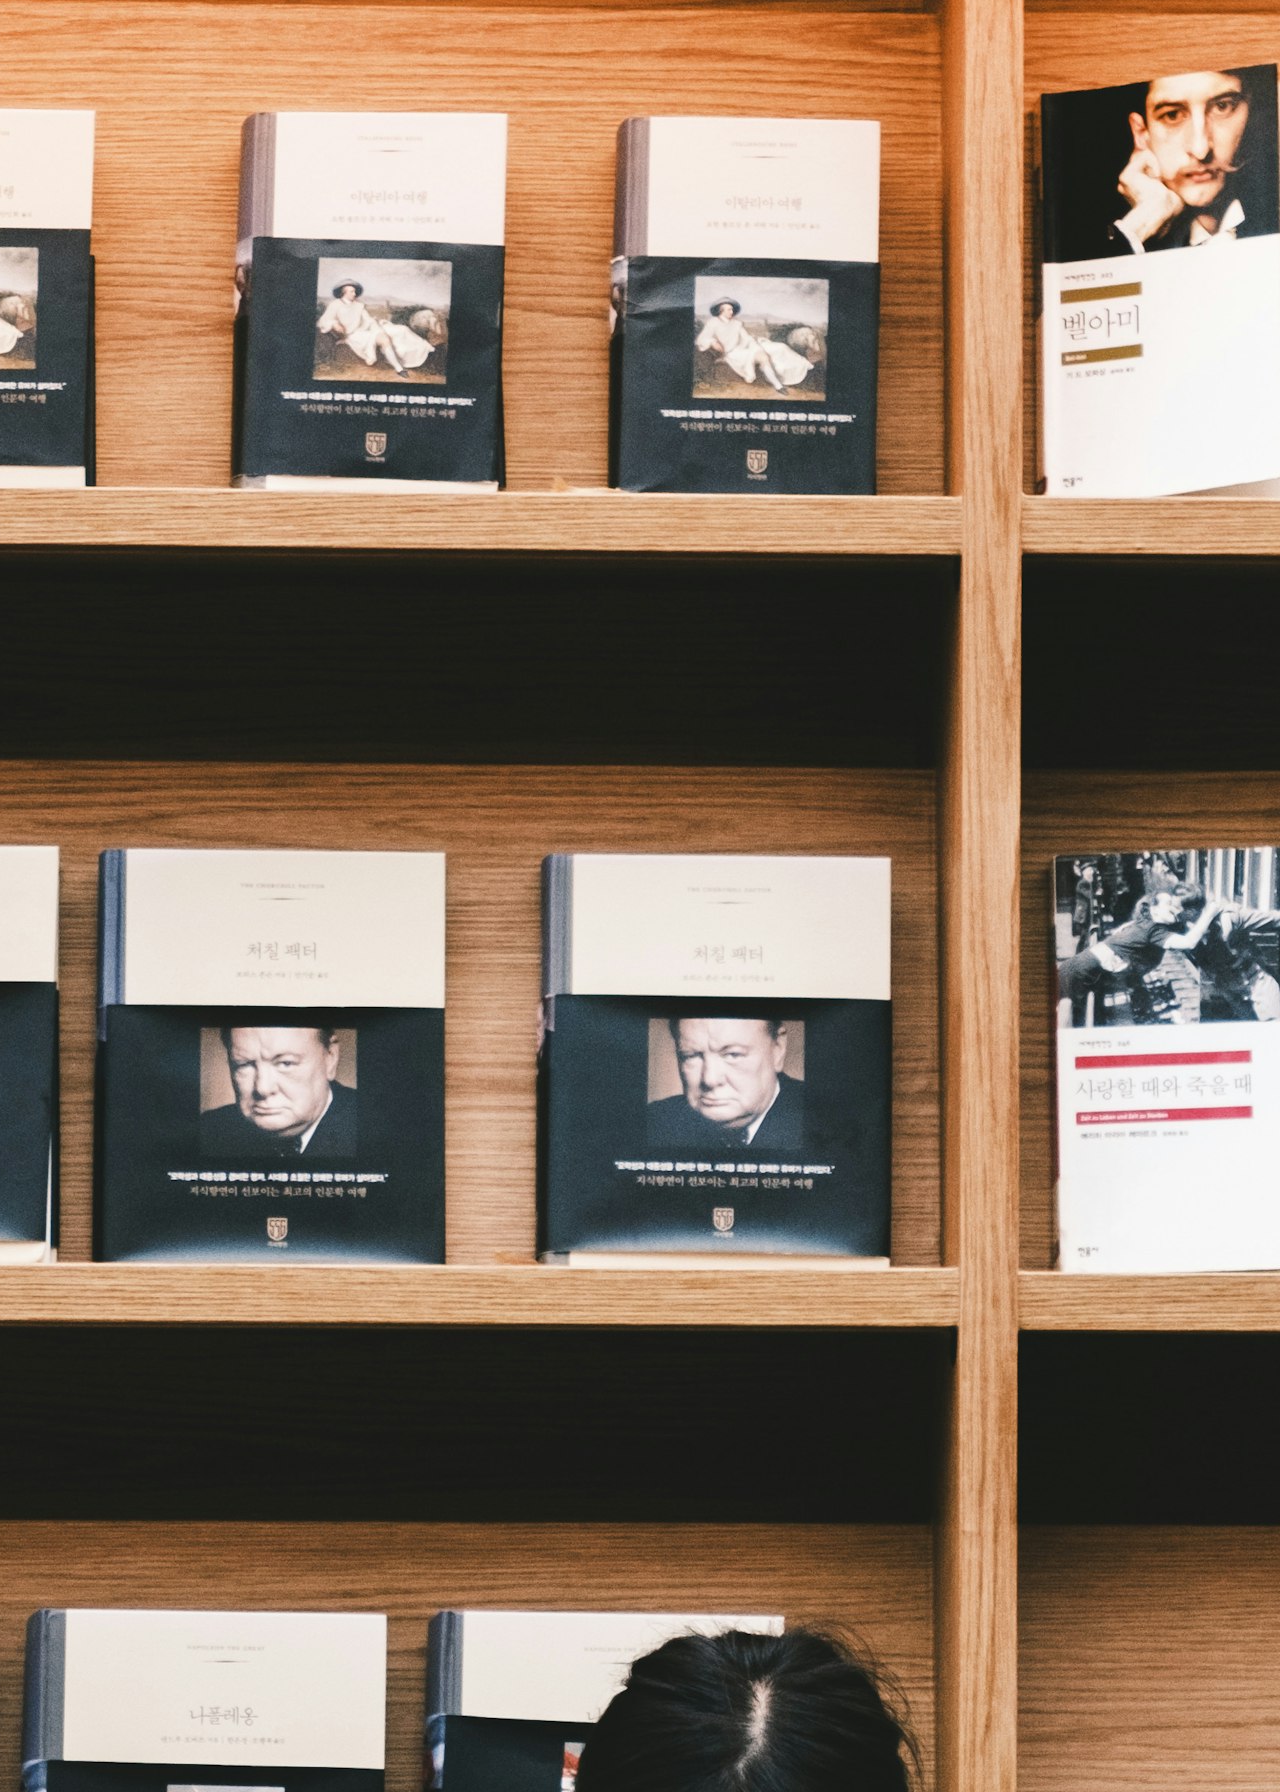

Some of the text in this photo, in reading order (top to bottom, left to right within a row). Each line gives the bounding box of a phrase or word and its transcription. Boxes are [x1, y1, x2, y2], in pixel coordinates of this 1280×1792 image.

[349, 189, 428, 206] 이탈리아 여행
[724, 195, 803, 212] 이탈리아 여행
[1059, 300, 1140, 341] 벨아미
[247, 941, 318, 961] 처칠 팩터
[693, 944, 764, 965] 처칠 팩터
[1076, 1073, 1252, 1101] 사랑할 때와 죽을 때
[189, 1705, 259, 1727] 나폴레옹
